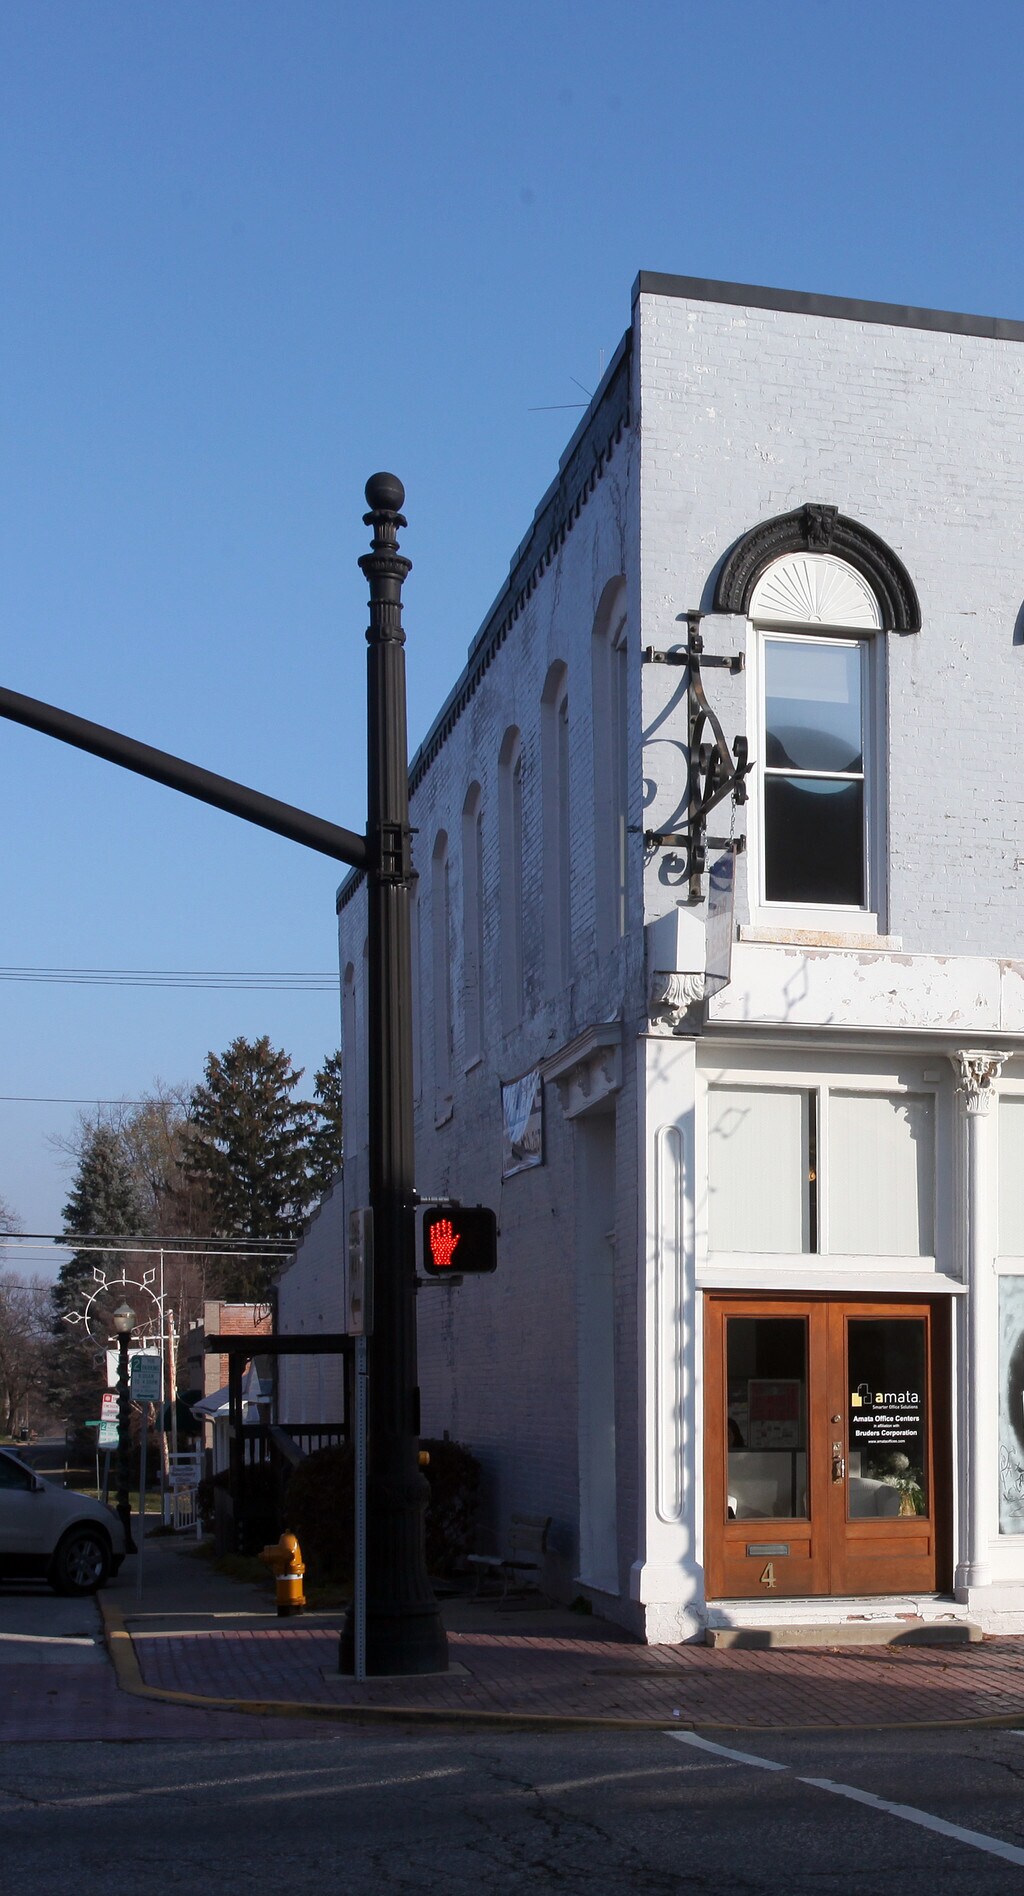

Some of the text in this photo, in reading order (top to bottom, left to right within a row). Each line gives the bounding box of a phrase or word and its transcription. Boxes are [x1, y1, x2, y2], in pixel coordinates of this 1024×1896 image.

[133, 1358, 140, 1370] 2
[881, 1429, 918, 1438] Corporation
[761, 1562, 777, 1588] 4
